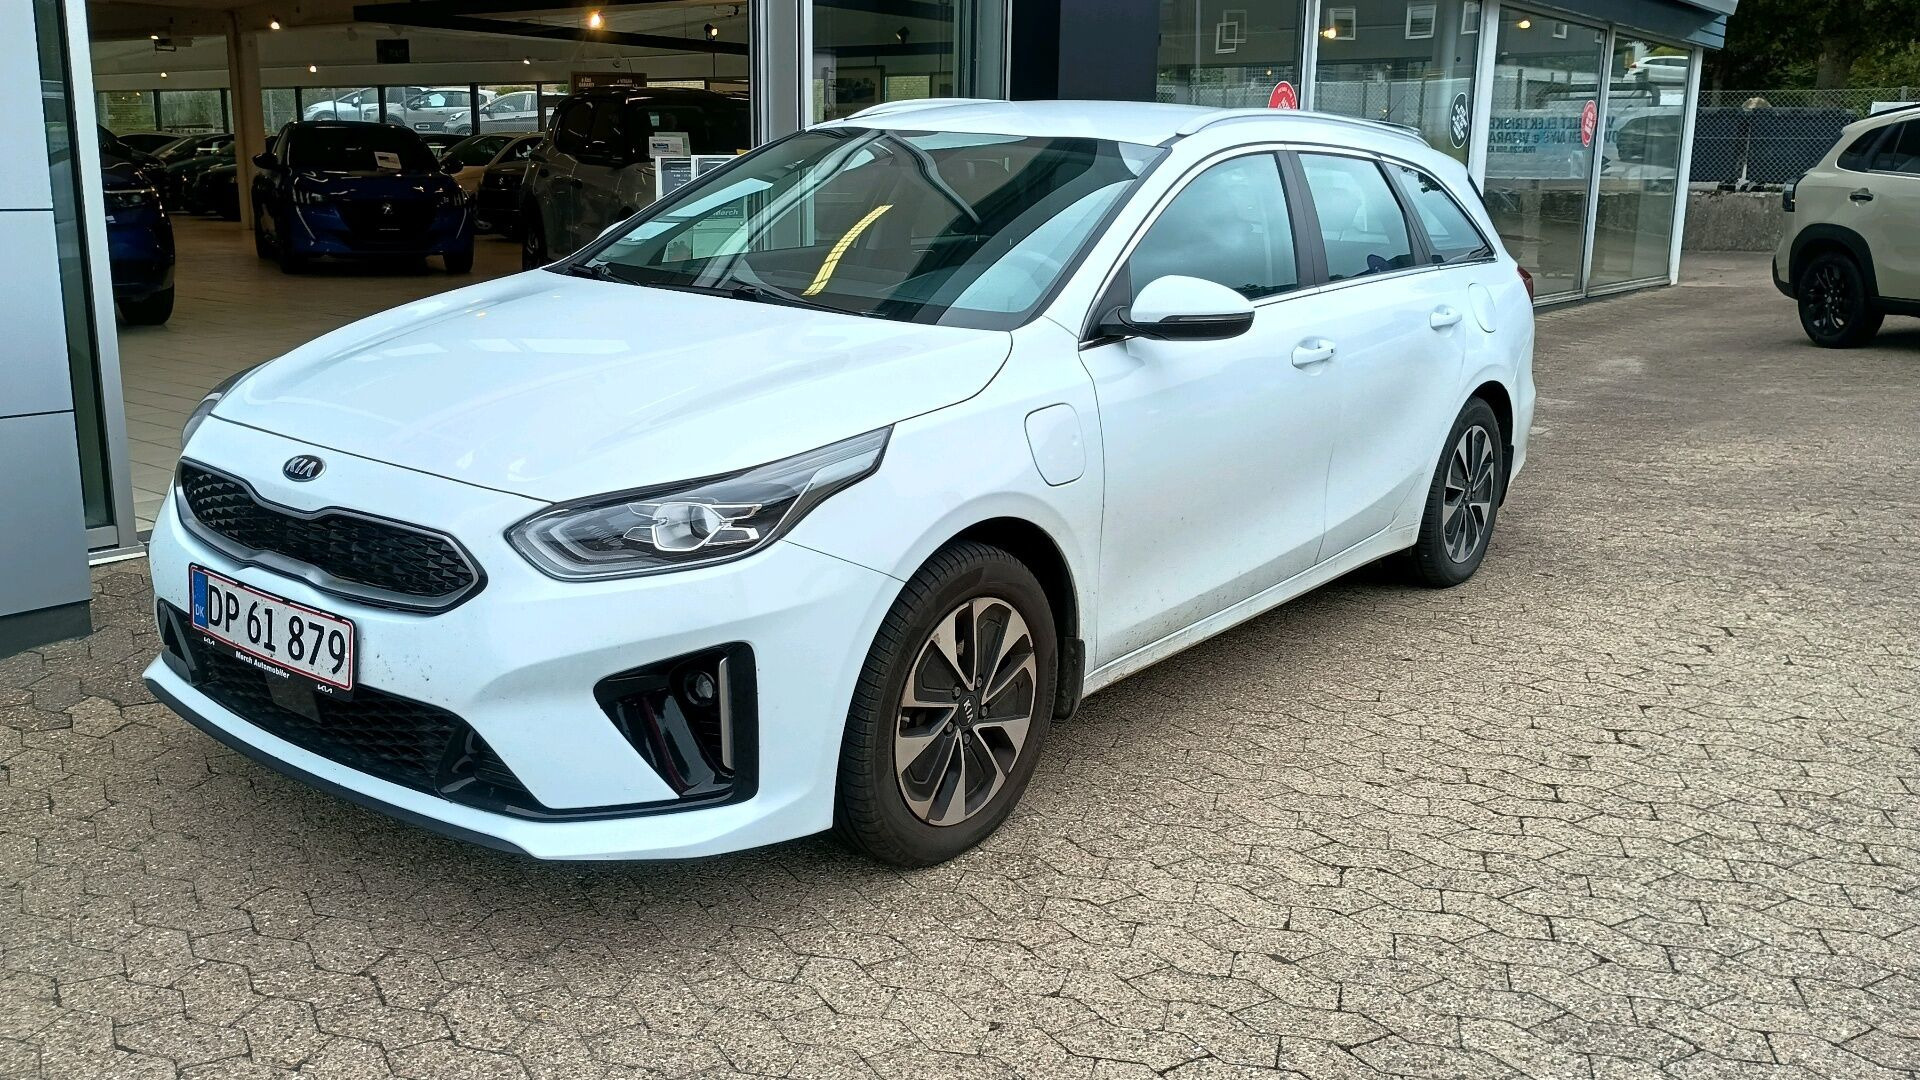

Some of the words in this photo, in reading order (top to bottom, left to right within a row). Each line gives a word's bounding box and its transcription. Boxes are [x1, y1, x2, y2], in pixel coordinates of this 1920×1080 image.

[285, 457, 317, 477] KIA
[195, 605, 205, 618] DK
[208, 584, 240, 633] DP
[247, 601, 276, 653] 61
[287, 615, 346, 675] 879
[253, 659, 290, 679] Automobiler
[963, 699, 974, 723] KIA
